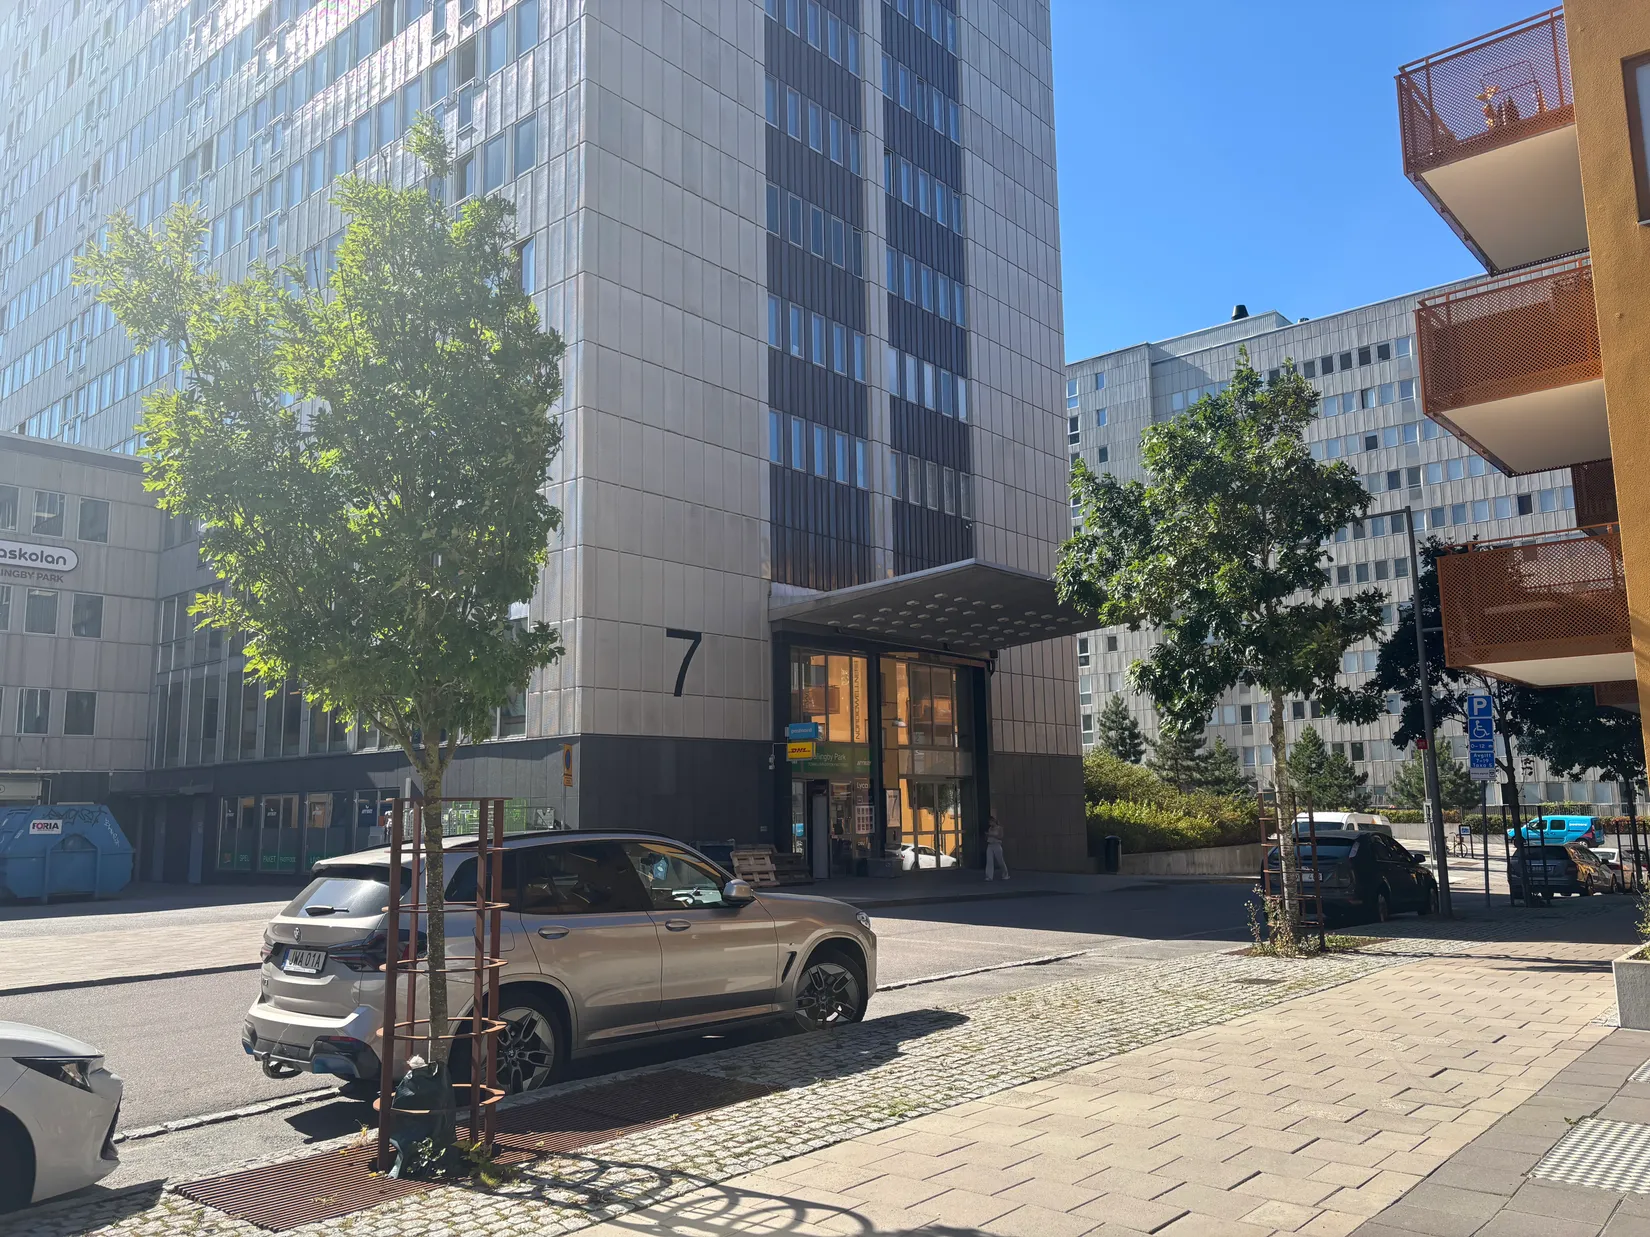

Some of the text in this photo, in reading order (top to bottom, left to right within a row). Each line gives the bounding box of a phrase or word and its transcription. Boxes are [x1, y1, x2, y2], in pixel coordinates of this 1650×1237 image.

[36, 572, 64, 584] PARK
[666, 628, 702, 697] 7
[1473, 697, 1487, 716] P
[31, 822, 59, 830] FORIA
